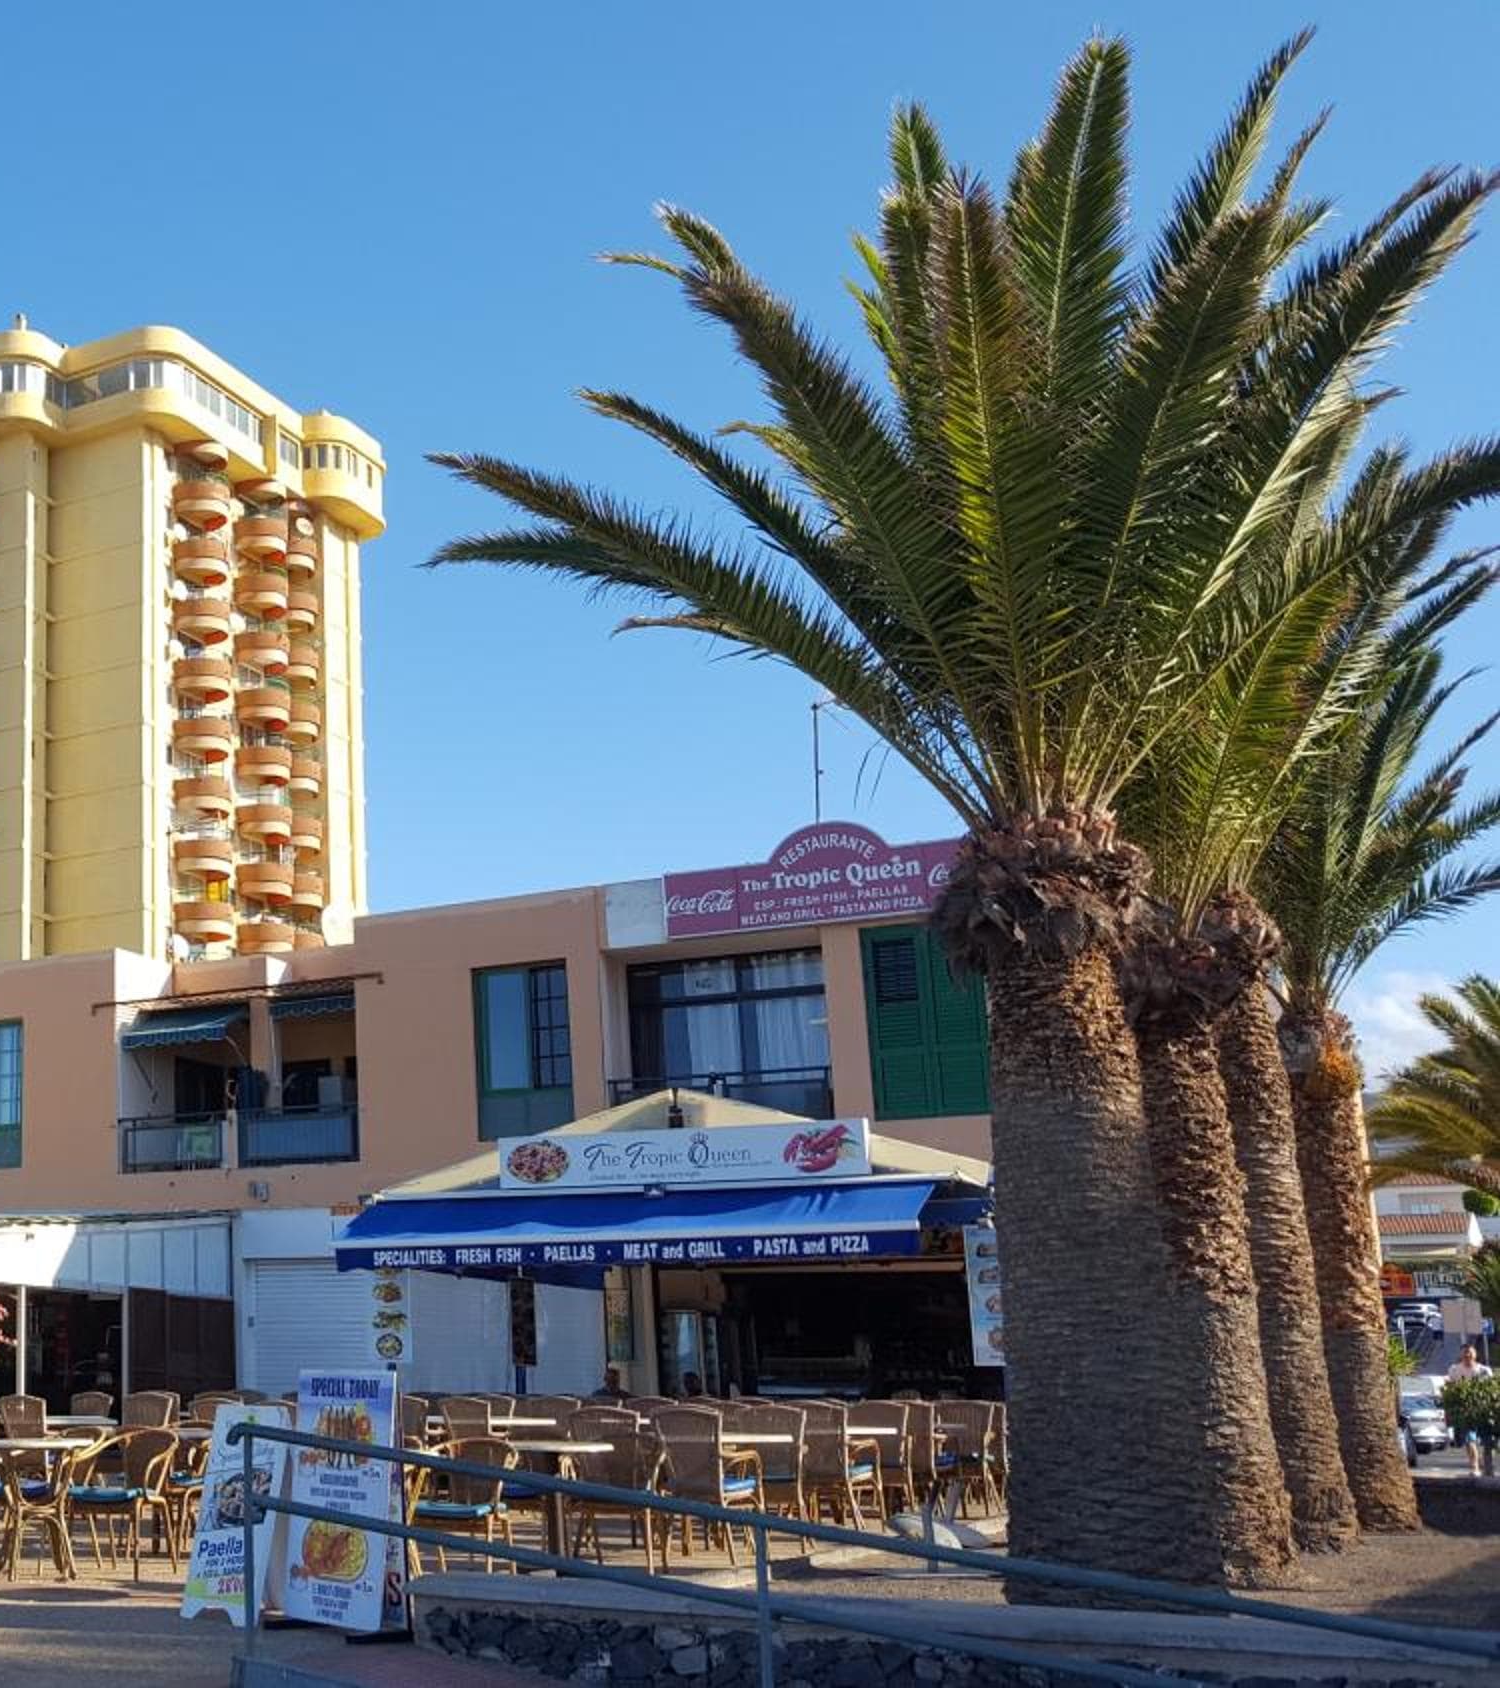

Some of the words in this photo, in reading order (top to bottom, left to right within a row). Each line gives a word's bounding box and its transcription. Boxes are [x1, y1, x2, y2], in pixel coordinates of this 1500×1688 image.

[779, 832, 876, 869] RESTAURANTE
[741, 879, 770, 892] The
[771, 866, 841, 890] Tropic
[845, 859, 922, 888] Queen
[823, 891, 849, 904] FISH
[857, 884, 909, 899] PAELLAS
[740, 912, 768, 926] MEAT
[769, 910, 791, 922] AND
[793, 907, 825, 920] GRILL
[833, 903, 867, 917] PASTA
[867, 900, 890, 912] AND
[892, 895, 925, 909] PIZZA
[583, 1142, 621, 1171] The
[625, 1141, 683, 1170] Tropic
[687, 1138, 751, 1169] Queen
[373, 1249, 447, 1267] SPECIALITIES:
[455, 1247, 491, 1265] FRESH
[496, 1246, 522, 1264] FISH
[543, 1244, 596, 1262] PAELLAS
[623, 1241, 658, 1260] MEAT
[661, 1242, 684, 1259] and
[688, 1240, 726, 1259] GRILL
[753, 1237, 798, 1256] PASTA
[802, 1236, 826, 1255] and
[831, 1234, 870, 1253] PIZZA
[310, 1376, 346, 1399] SPECIAL
[349, 1378, 381, 1399] TODAY
[197, 1535, 243, 1559] Paella
